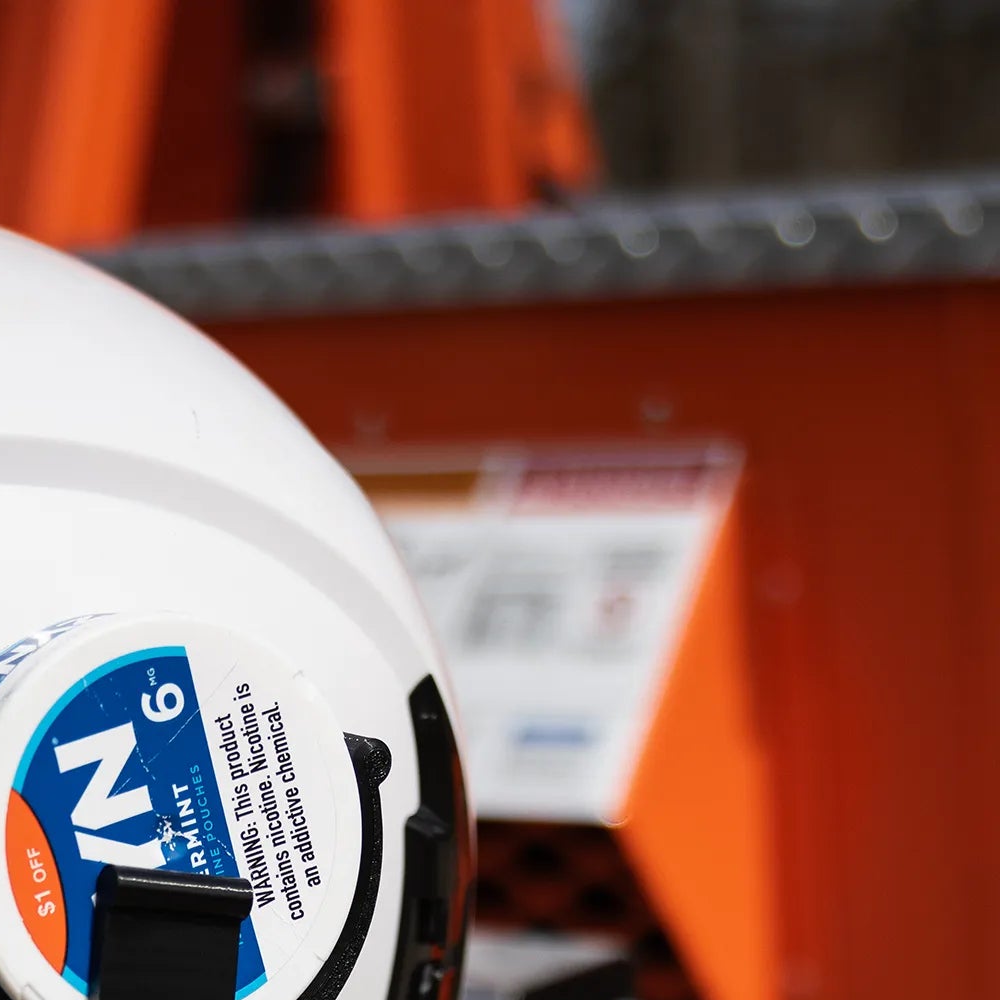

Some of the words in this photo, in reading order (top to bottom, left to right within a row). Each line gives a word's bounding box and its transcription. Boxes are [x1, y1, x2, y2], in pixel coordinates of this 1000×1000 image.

[141, 683, 185, 722] 6
[147, 667, 157, 686] MG
[233, 683, 251, 701] is
[214, 713, 250, 781] product
[240, 703, 268, 774] Nicotine
[261, 701, 296, 783] chemical.
[54, 721, 167, 907] YN
[190, 764, 217, 842] POUCHES
[231, 783, 254, 822] This
[258, 775, 286, 847] nicotine.
[285, 787, 315, 863] addictive
[26, 848, 47, 883] OFF
[210, 848, 225, 876] INE
[240, 821, 276, 909] WARNING:
[275, 850, 305, 921] contains
[304, 865, 322, 888] an
[33, 890, 56, 917] $1
